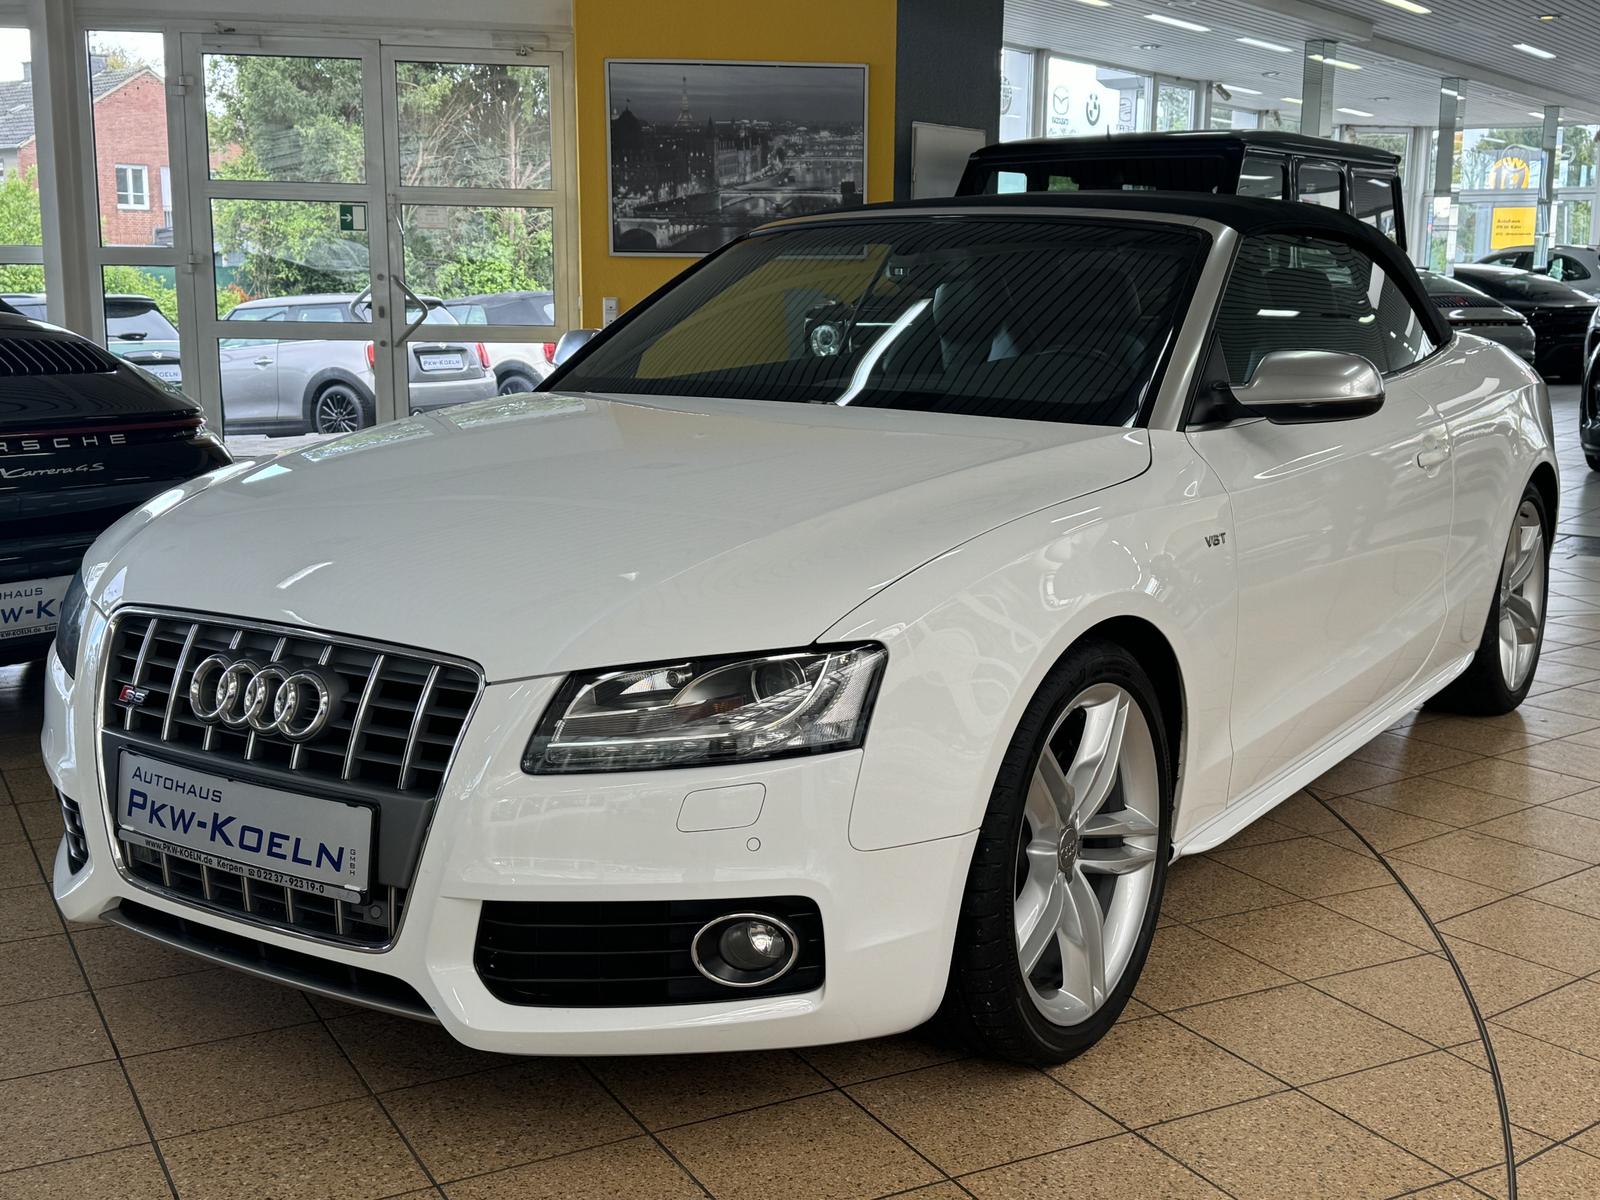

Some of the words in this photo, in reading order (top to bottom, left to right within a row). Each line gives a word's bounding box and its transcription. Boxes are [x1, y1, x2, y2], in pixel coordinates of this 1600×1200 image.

[0, 467, 74, 479] Carrera
[132, 766, 222, 803] AUTOHAUS
[127, 788, 345, 873] PKW-KOELN
[144, 839, 213, 865] www.PKW-KOELN.de
[216, 859, 244, 874] Kerpen
